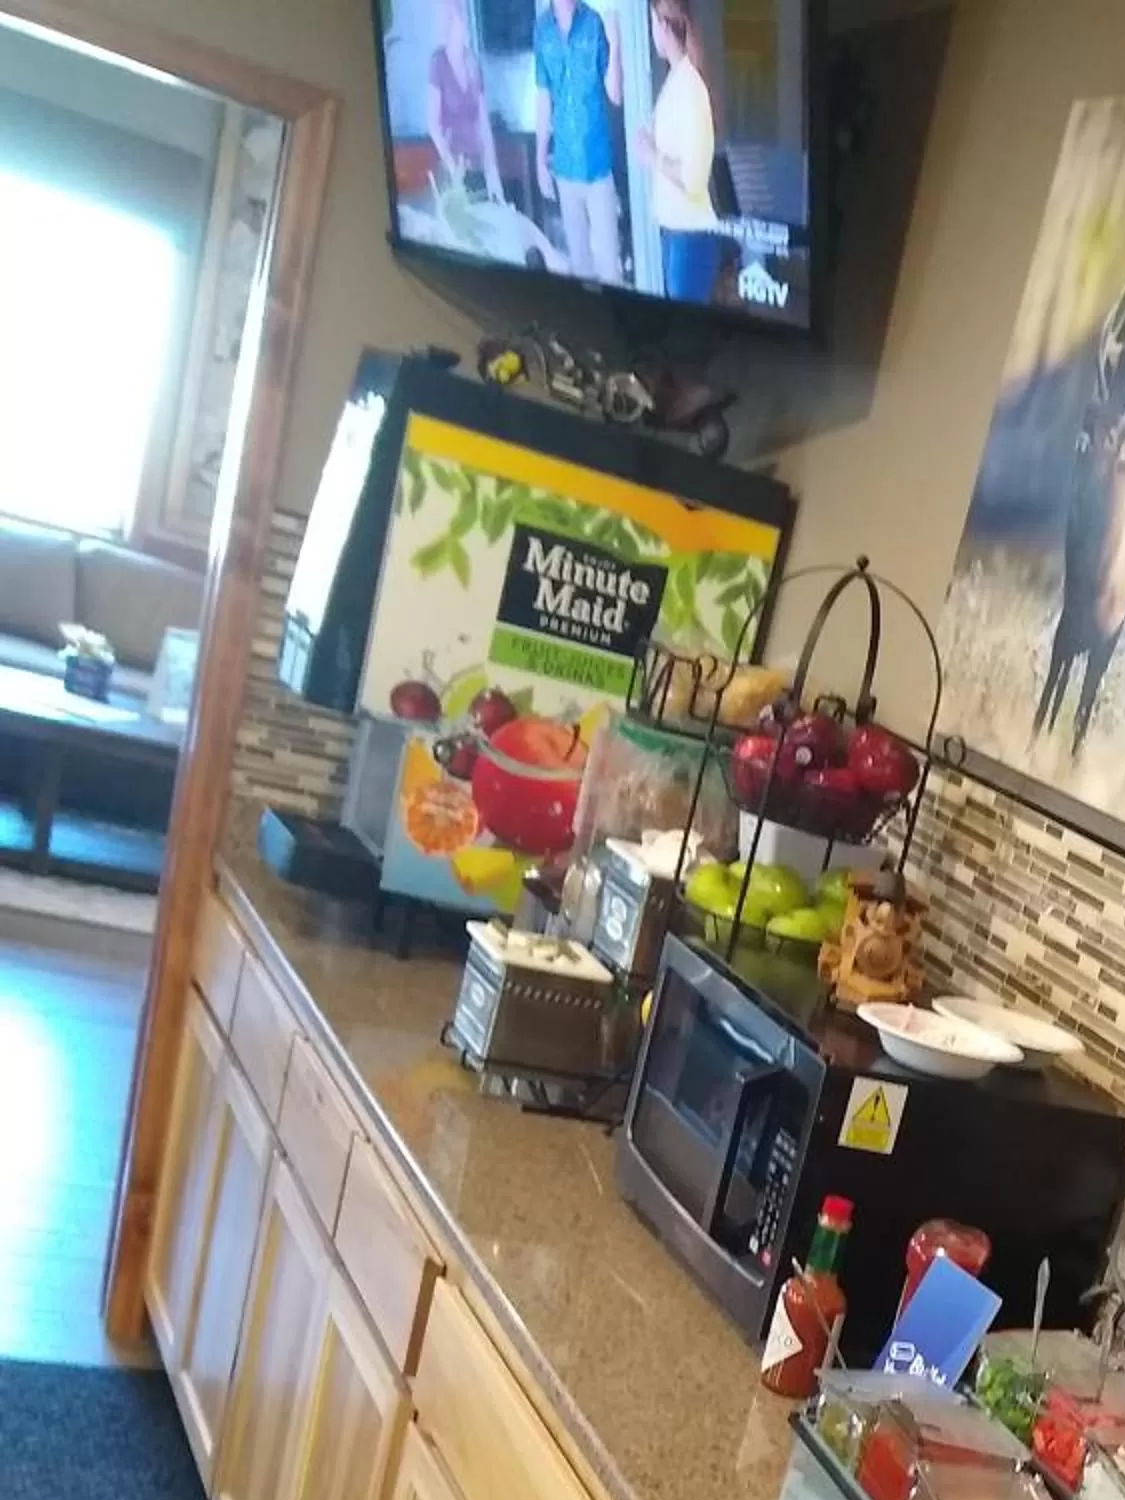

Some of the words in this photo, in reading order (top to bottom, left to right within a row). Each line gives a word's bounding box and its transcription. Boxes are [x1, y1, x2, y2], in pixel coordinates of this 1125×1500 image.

[522, 536, 650, 605] Minute
[532, 574, 627, 634] Maid
[539, 612, 612, 646] PREMIUM
